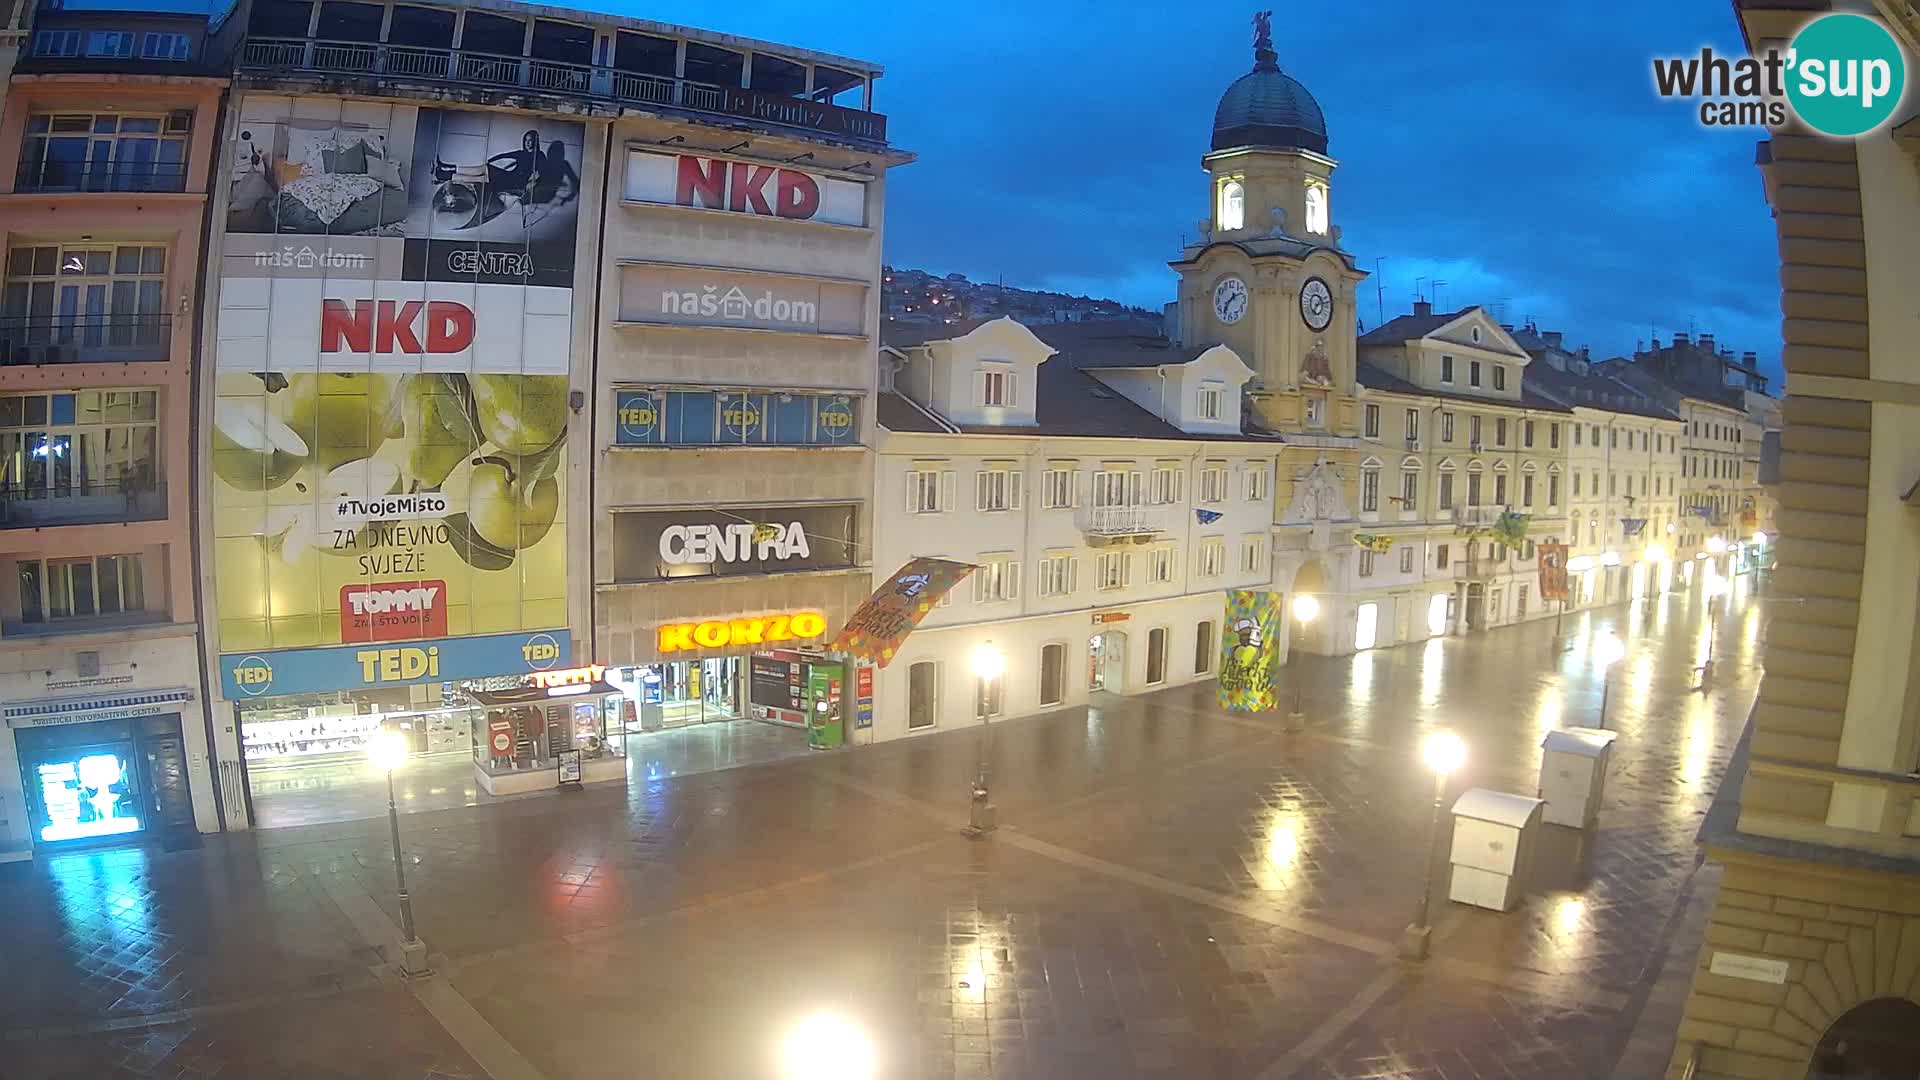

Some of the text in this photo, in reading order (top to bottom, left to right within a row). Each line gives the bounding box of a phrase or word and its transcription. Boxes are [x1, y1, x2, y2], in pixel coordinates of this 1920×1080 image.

[674, 154, 820, 220] NKD
[254, 245, 365, 269] naš dom
[447, 250, 534, 276] CENTRA
[661, 284, 816, 323] naš dom
[320, 298, 477, 354] NKD
[618, 408, 657, 425] TEDi
[722, 409, 760, 426] TEDi
[337, 497, 446, 516] #TvojeMisto
[333, 525, 450, 549] ZA DNEVNO
[659, 521, 810, 564] CENTRA
[358, 549, 426, 576] SVJEŽE
[348, 587, 438, 615] TOMMY
[379, 615, 399, 626] ŠTO
[658, 611, 826, 653] KORZO
[357, 646, 439, 682] TEDi
[522, 642, 560, 662] TEDi
[233, 666, 272, 685] TEDi
[534, 665, 606, 688] TOMMY
